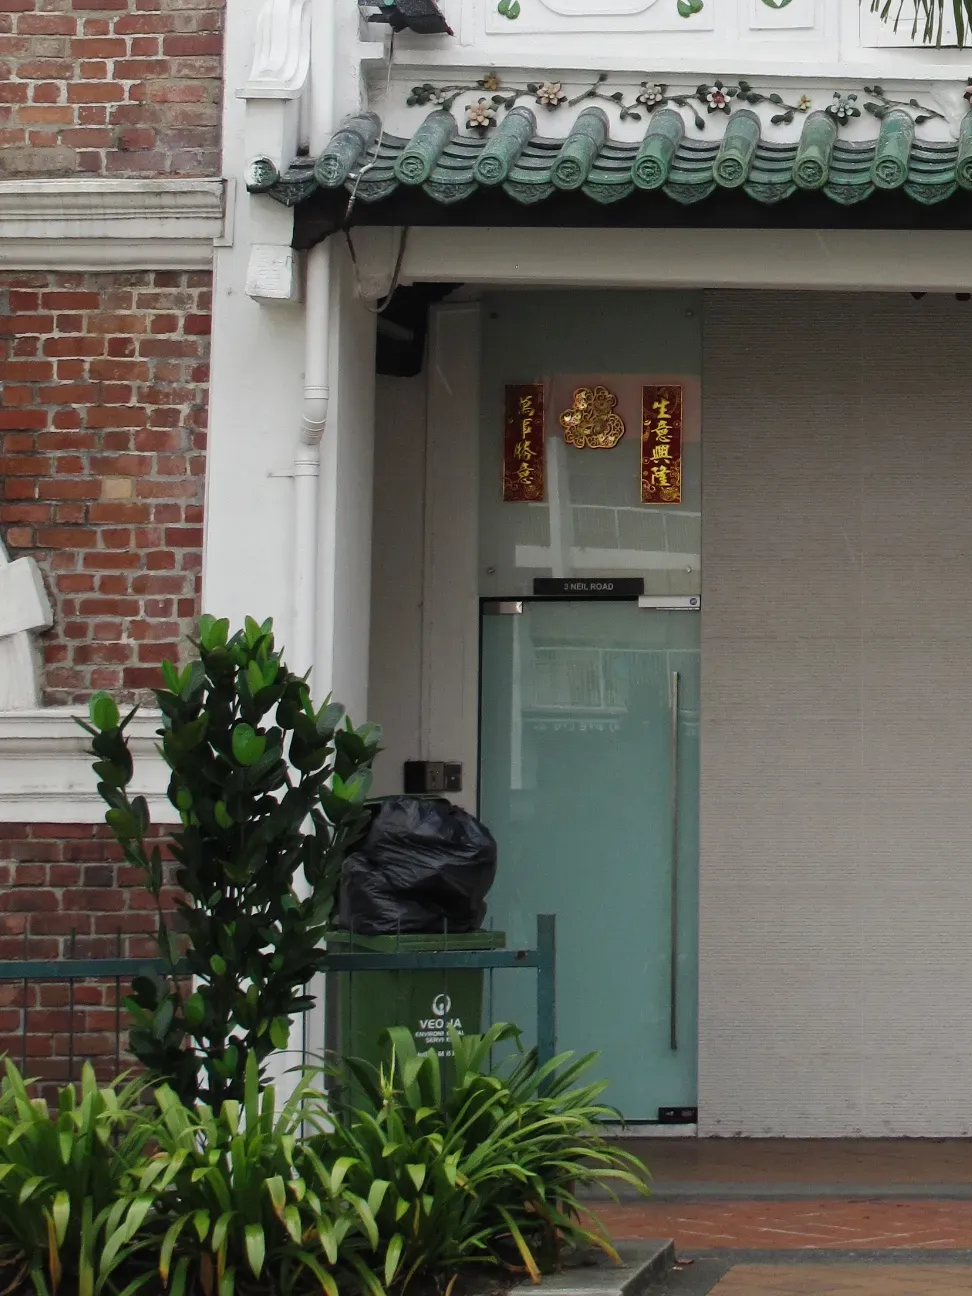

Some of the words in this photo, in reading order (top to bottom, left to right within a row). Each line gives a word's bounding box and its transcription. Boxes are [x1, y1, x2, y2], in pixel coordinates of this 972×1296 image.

[649, 400, 673, 488] 生意興隆
[563, 582, 569, 591] 3
[570, 582, 588, 591] NEIL
[590, 582, 614, 591] ROAD
[419, 1018, 462, 1030] VEOIA
